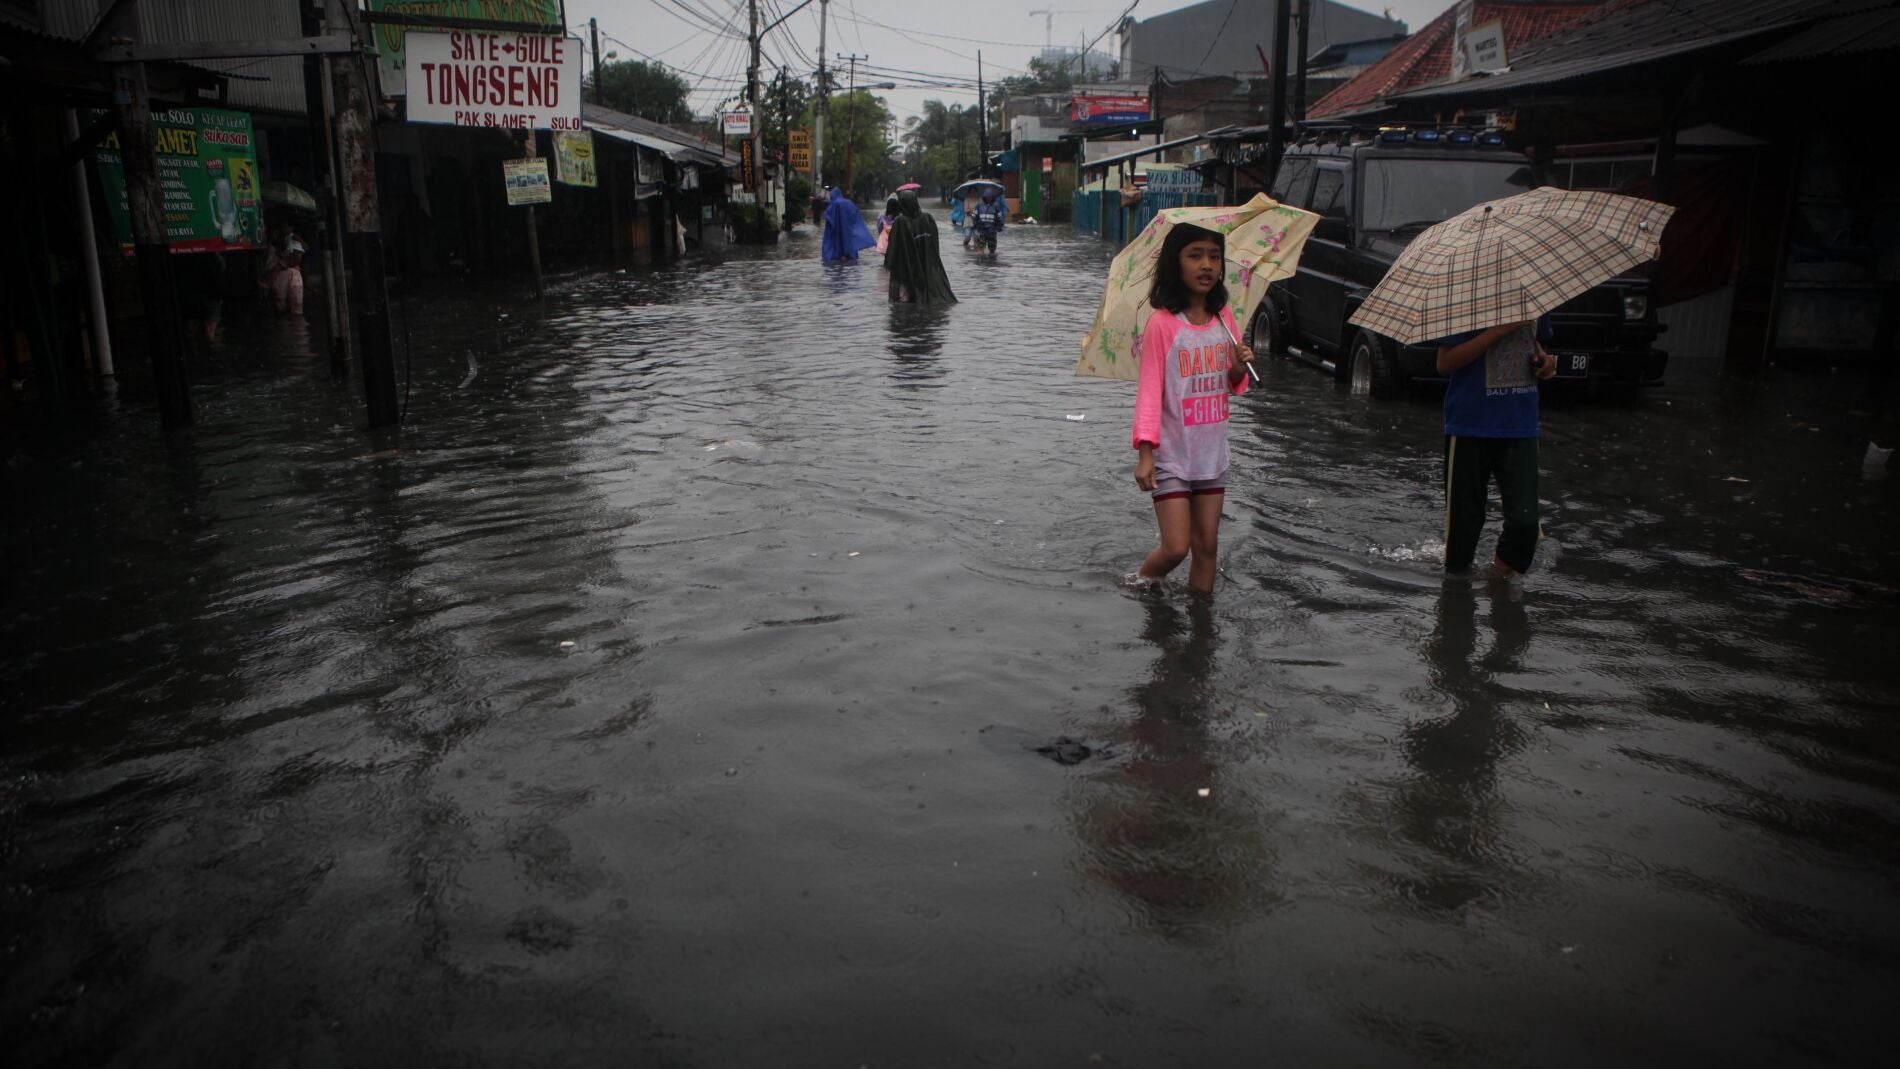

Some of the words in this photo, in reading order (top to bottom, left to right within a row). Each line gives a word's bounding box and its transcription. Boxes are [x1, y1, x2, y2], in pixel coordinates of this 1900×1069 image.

[451, 31, 499, 61] SATE
[515, 35, 564, 64] GULE
[421, 63, 560, 108] TONGSENG
[169, 110, 195, 125] SOLO
[455, 111, 480, 129] PAK
[484, 112, 537, 130] SLAMET
[551, 117, 580, 130] SOLO
[1192, 377, 1215, 393] LIKE
[1218, 375, 1224, 390] A
[1193, 396, 1225, 423] GIRL
